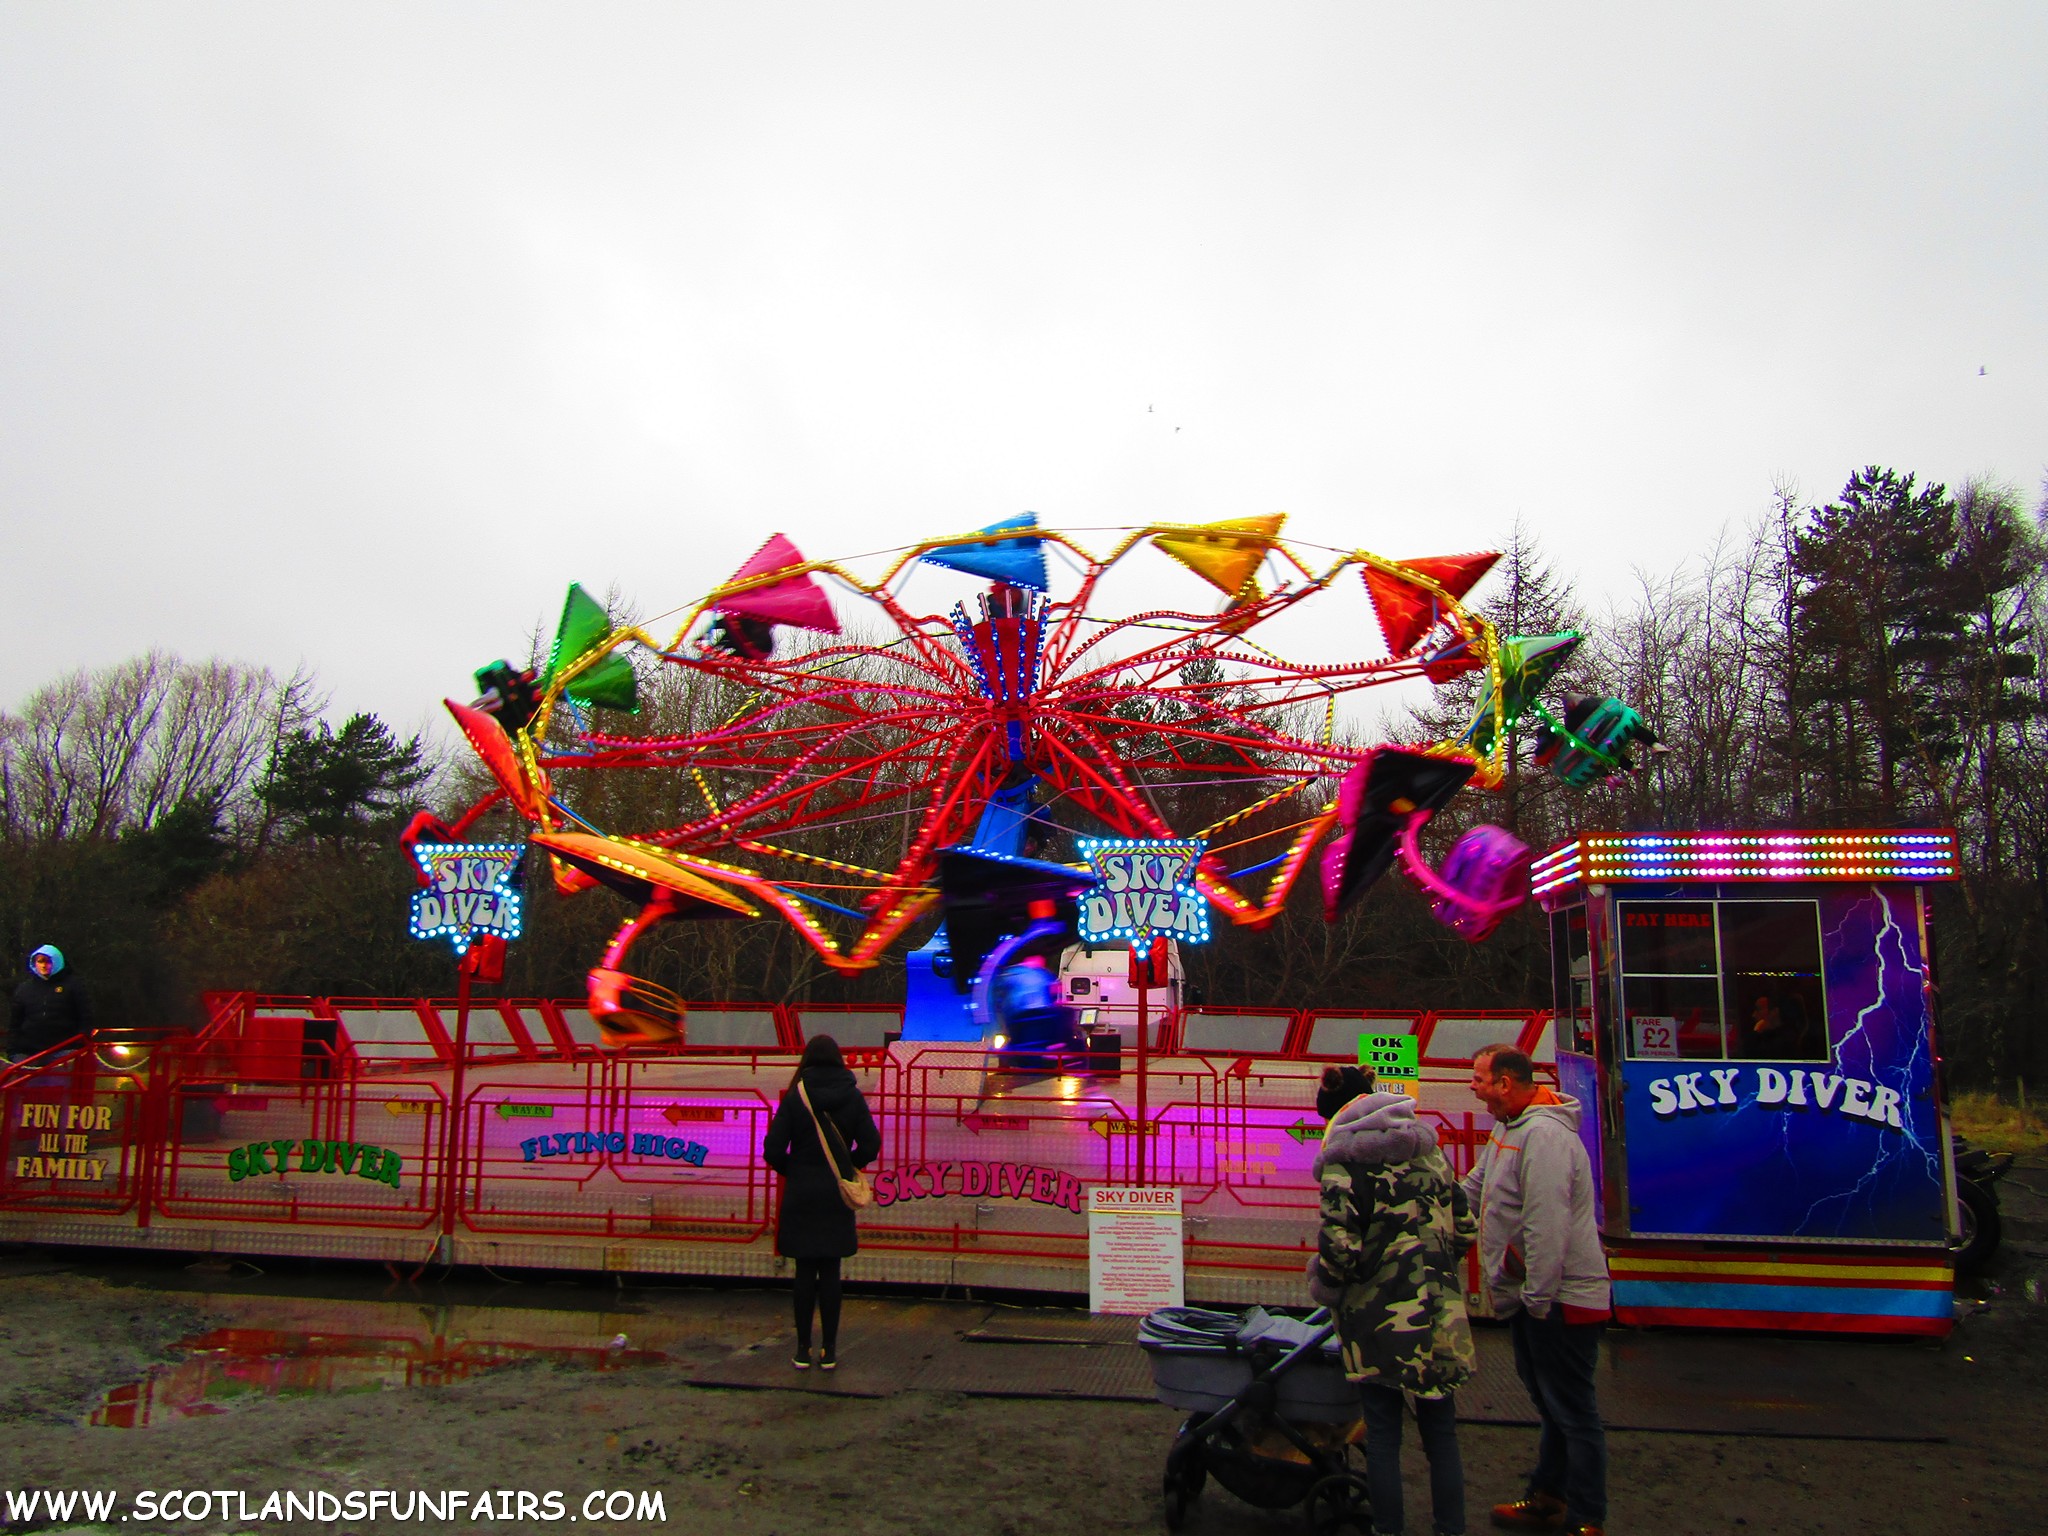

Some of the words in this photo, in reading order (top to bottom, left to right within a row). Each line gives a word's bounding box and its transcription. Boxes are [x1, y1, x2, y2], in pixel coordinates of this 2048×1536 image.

[438, 858, 505, 893] SKY
[1106, 854, 1184, 893] SKY
[419, 892, 514, 932] DIVER
[1086, 892, 1201, 935] DIVER
[1626, 913, 1659, 928] PAY
[1664, 913, 1711, 928] HERE
[1636, 1018, 1661, 1027] FARE
[1372, 1037, 1404, 1049] OK
[1643, 1027, 1671, 1049] £2
[1369, 1050, 1399, 1062] TO
[1373, 1065, 1415, 1076] IDE
[1393, 1082, 1405, 1095] BE
[1649, 1068, 1739, 1116] SKY
[1756, 1067, 1903, 1128] DIVER
[21, 1103, 61, 1128] FUN
[66, 1105, 112, 1130] FOR
[511, 1105, 532, 1115] WAY
[38, 1133, 60, 1153] ALL
[65, 1134, 88, 1154] THE
[520, 1131, 626, 1163] FLYING
[632, 1132, 709, 1168] HIGH
[16, 1156, 107, 1181] FAMILY
[228, 1139, 295, 1183] SKY
[300, 1139, 402, 1189] DIVER
[874, 1161, 952, 1207] SKY
[960, 1161, 1081, 1214] DIVER
[1096, 1190, 1125, 1204] SKY
[1129, 1190, 1175, 1204] DIVER
